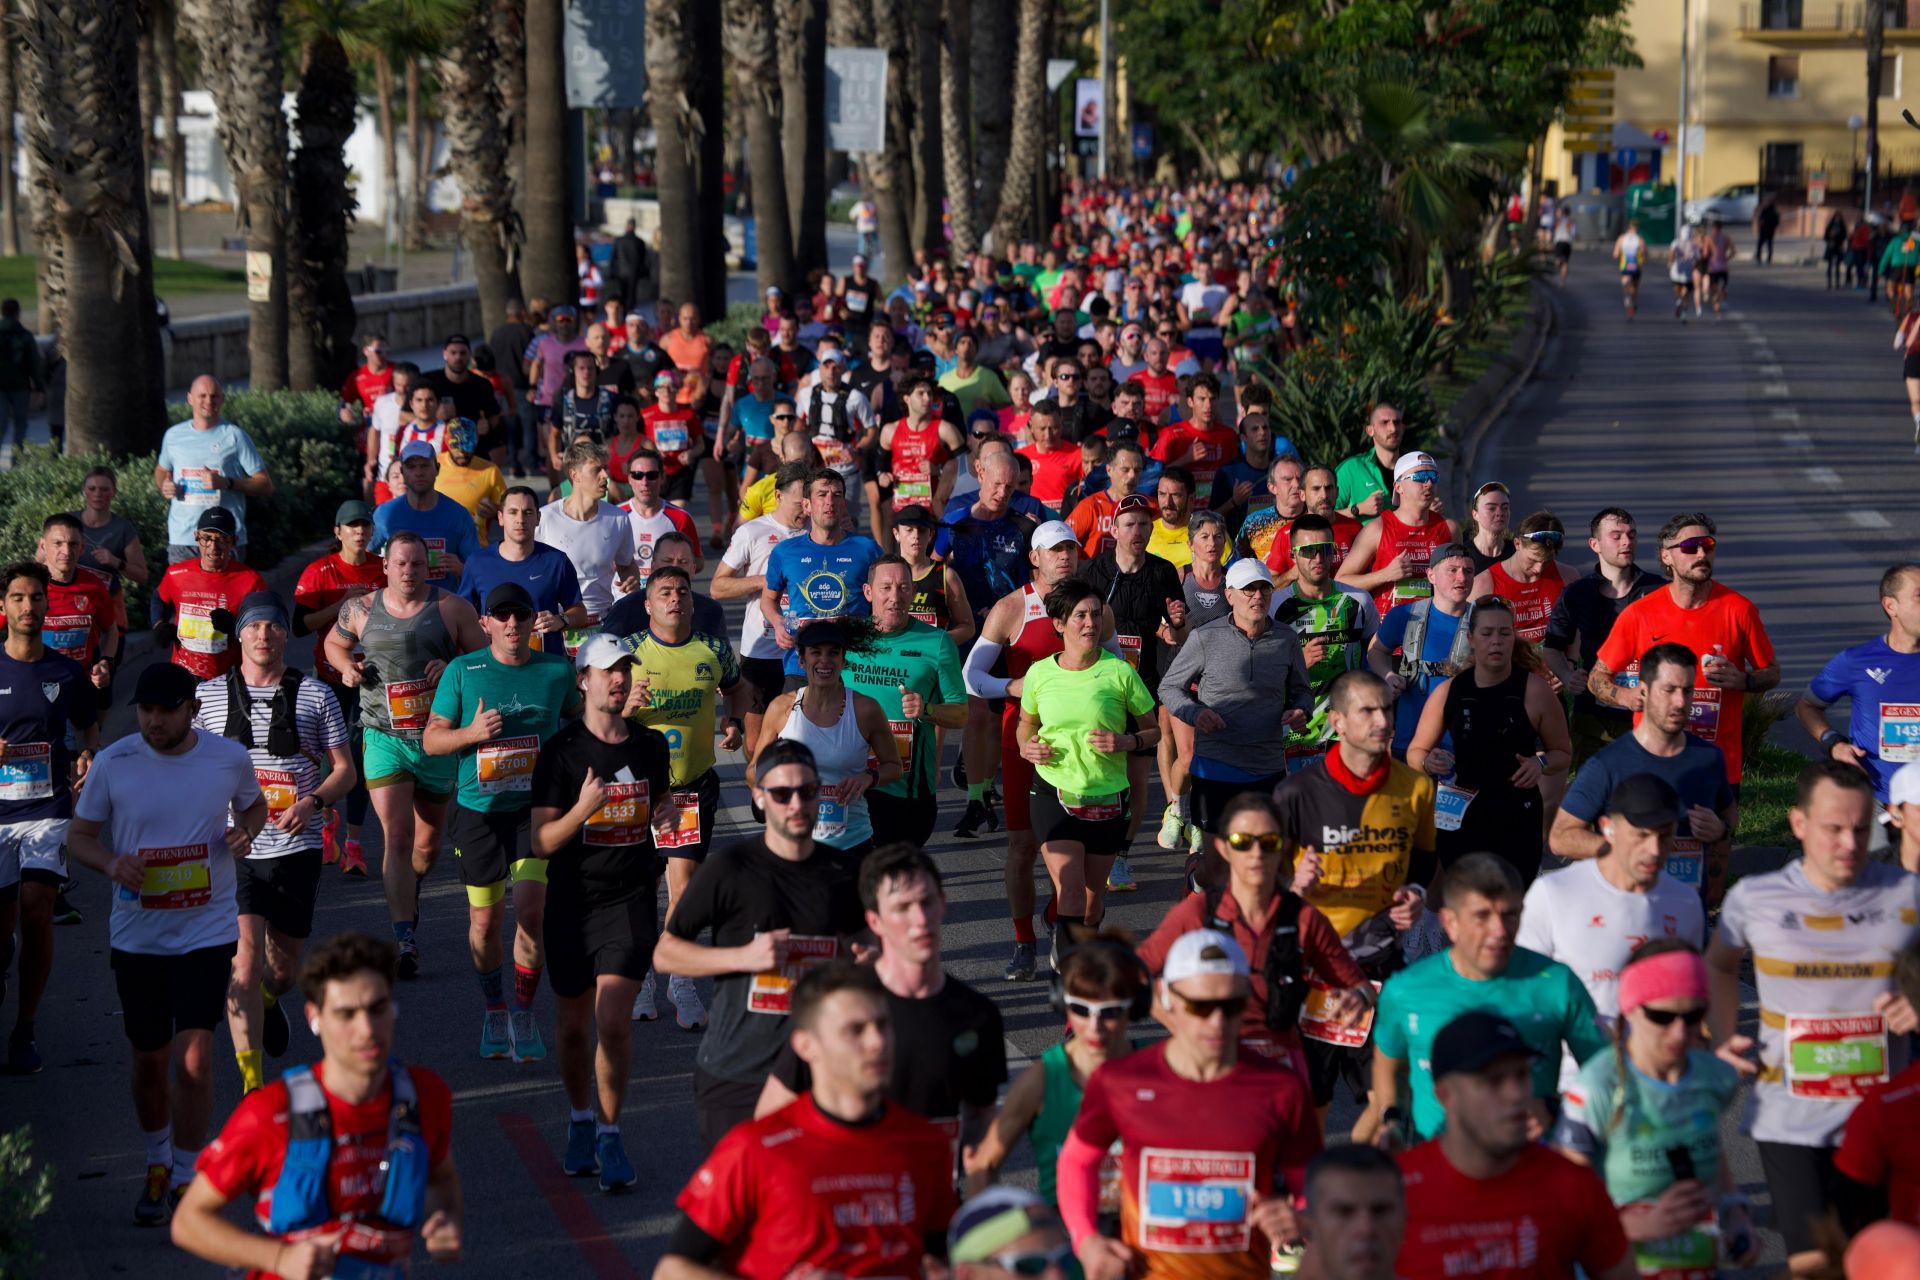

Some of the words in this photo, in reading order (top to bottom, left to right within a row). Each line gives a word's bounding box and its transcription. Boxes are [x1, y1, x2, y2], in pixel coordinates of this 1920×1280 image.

[1118, 637, 1142, 647] ERALI
[851, 662, 910, 679] BRAMHALL
[853, 674, 905, 688] RUNNERS
[650, 688, 690, 699] CANILLAS
[693, 688, 704, 698] DE
[1692, 691, 1718, 700] ERALI
[404, 697, 433, 709] 5114
[649, 698, 702, 711] ALBAIDA
[494, 739, 536, 752] GENERALI
[2, 764, 40, 776] 13423
[491, 757, 529, 771] 15708
[255, 771, 294, 783] ENERALI
[264, 790, 280, 801] 64
[607, 784, 646, 797] ENERALI
[603, 804, 636, 819] 5533
[818, 804, 834, 815] 03
[1322, 825, 1408, 845] bichos
[156, 847, 204, 860] GENERALI
[1323, 843, 1408, 855] runners
[159, 868, 193, 882] 3210
